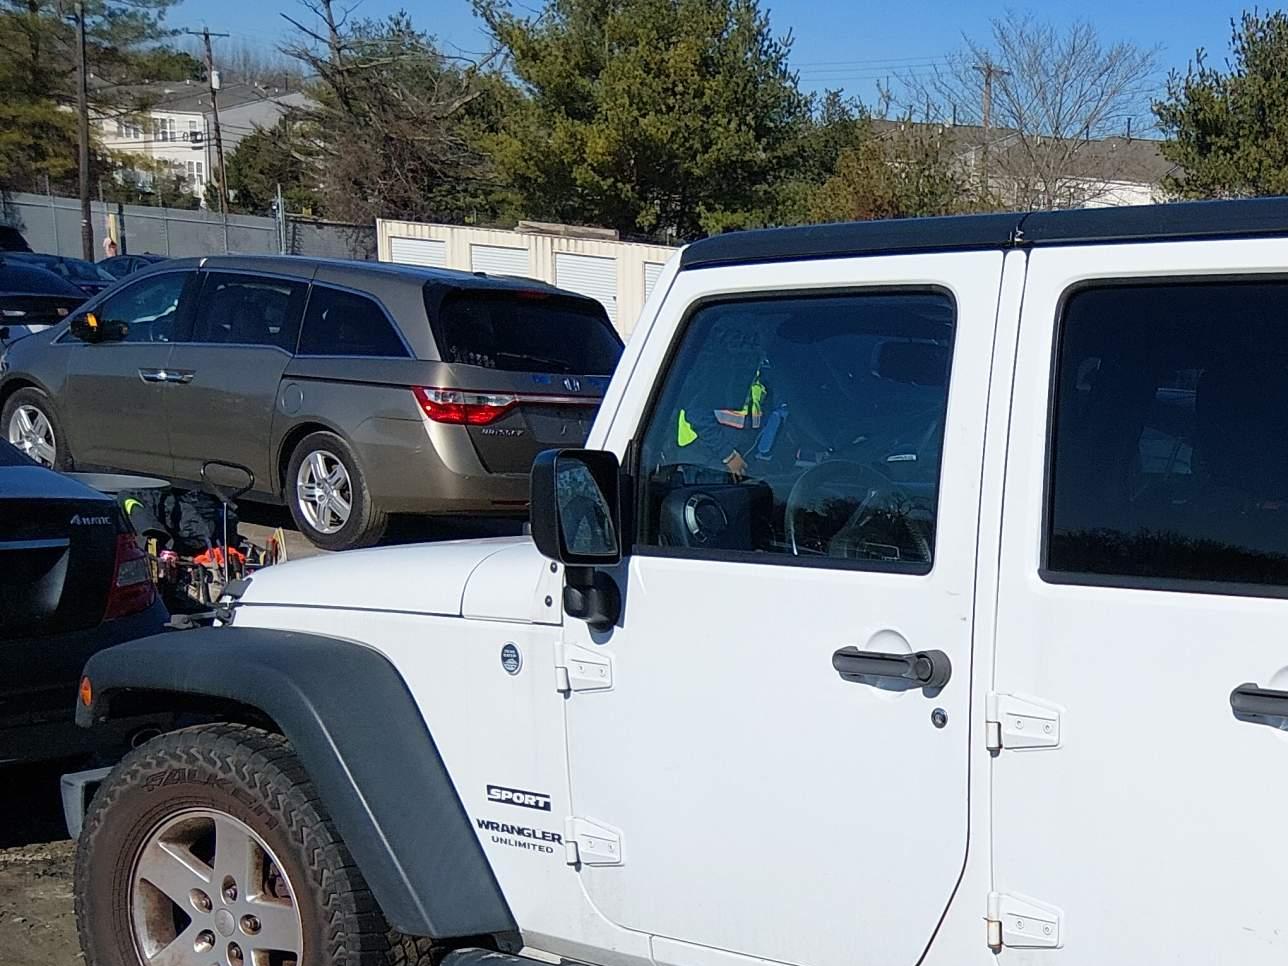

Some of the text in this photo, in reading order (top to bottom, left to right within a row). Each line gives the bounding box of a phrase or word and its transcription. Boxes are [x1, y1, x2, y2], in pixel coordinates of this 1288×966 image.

[488, 787, 550, 809] SPORT
[476, 818, 564, 847] WRANGLER
[491, 836, 554, 854] UNLIMITED
